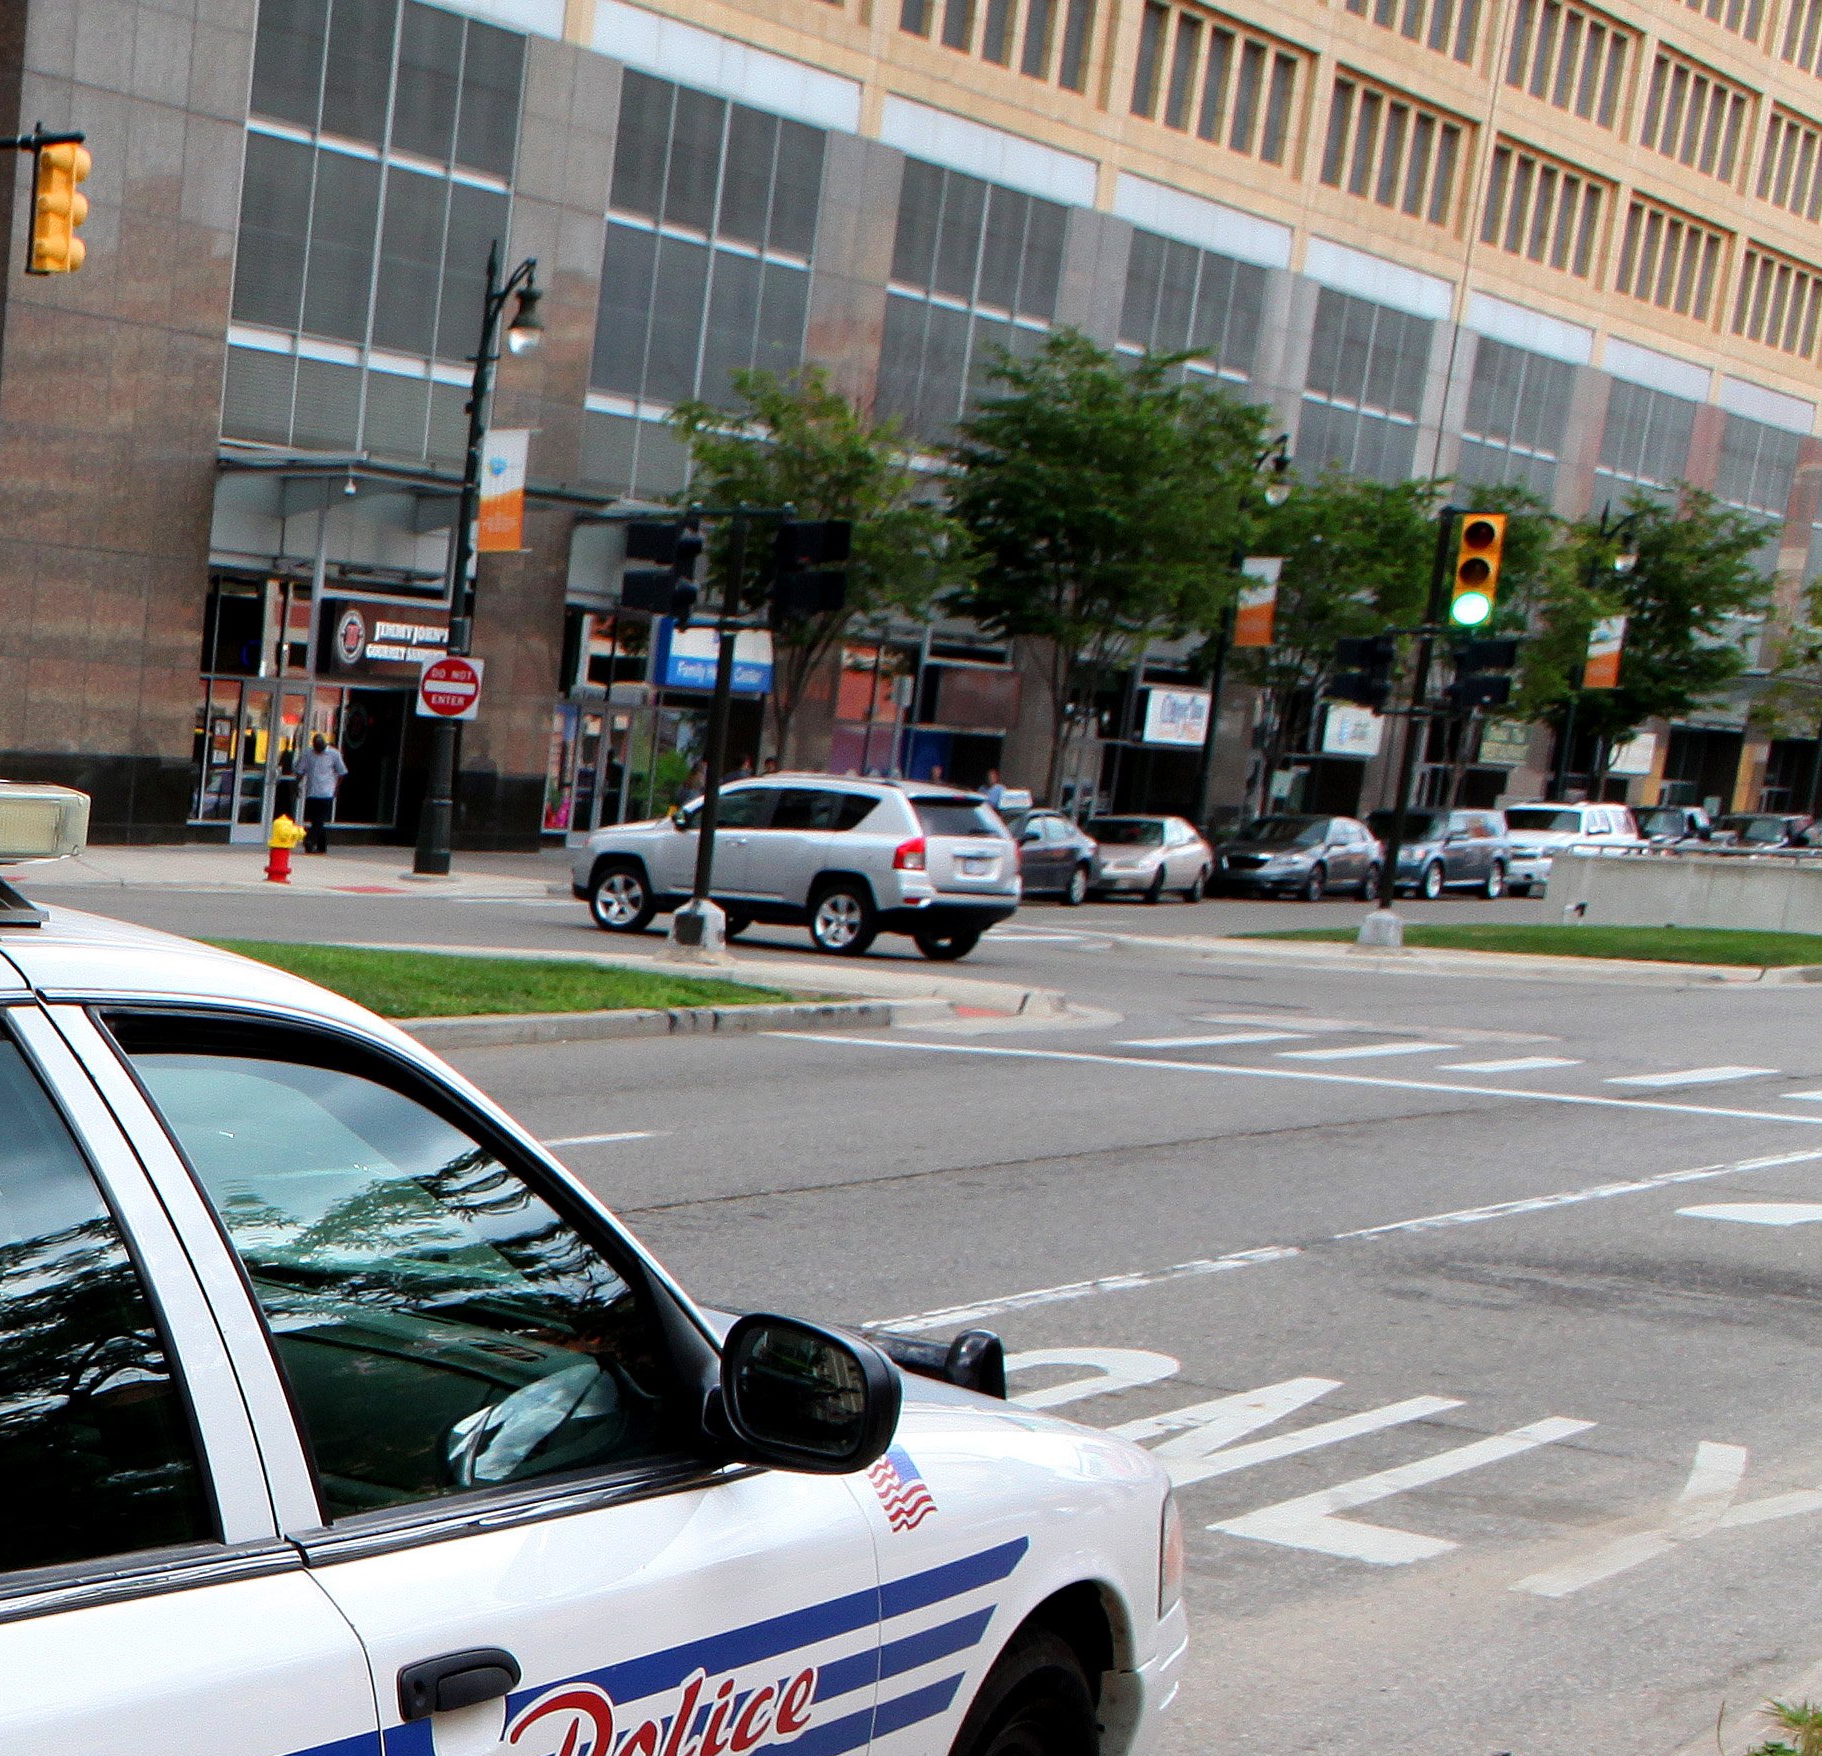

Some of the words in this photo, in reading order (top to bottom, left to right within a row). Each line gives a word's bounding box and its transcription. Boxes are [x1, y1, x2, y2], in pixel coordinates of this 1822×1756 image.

[431, 668, 446, 678] DO
[452, 670, 472, 681] NOT
[431, 695, 465, 706] ENTER
